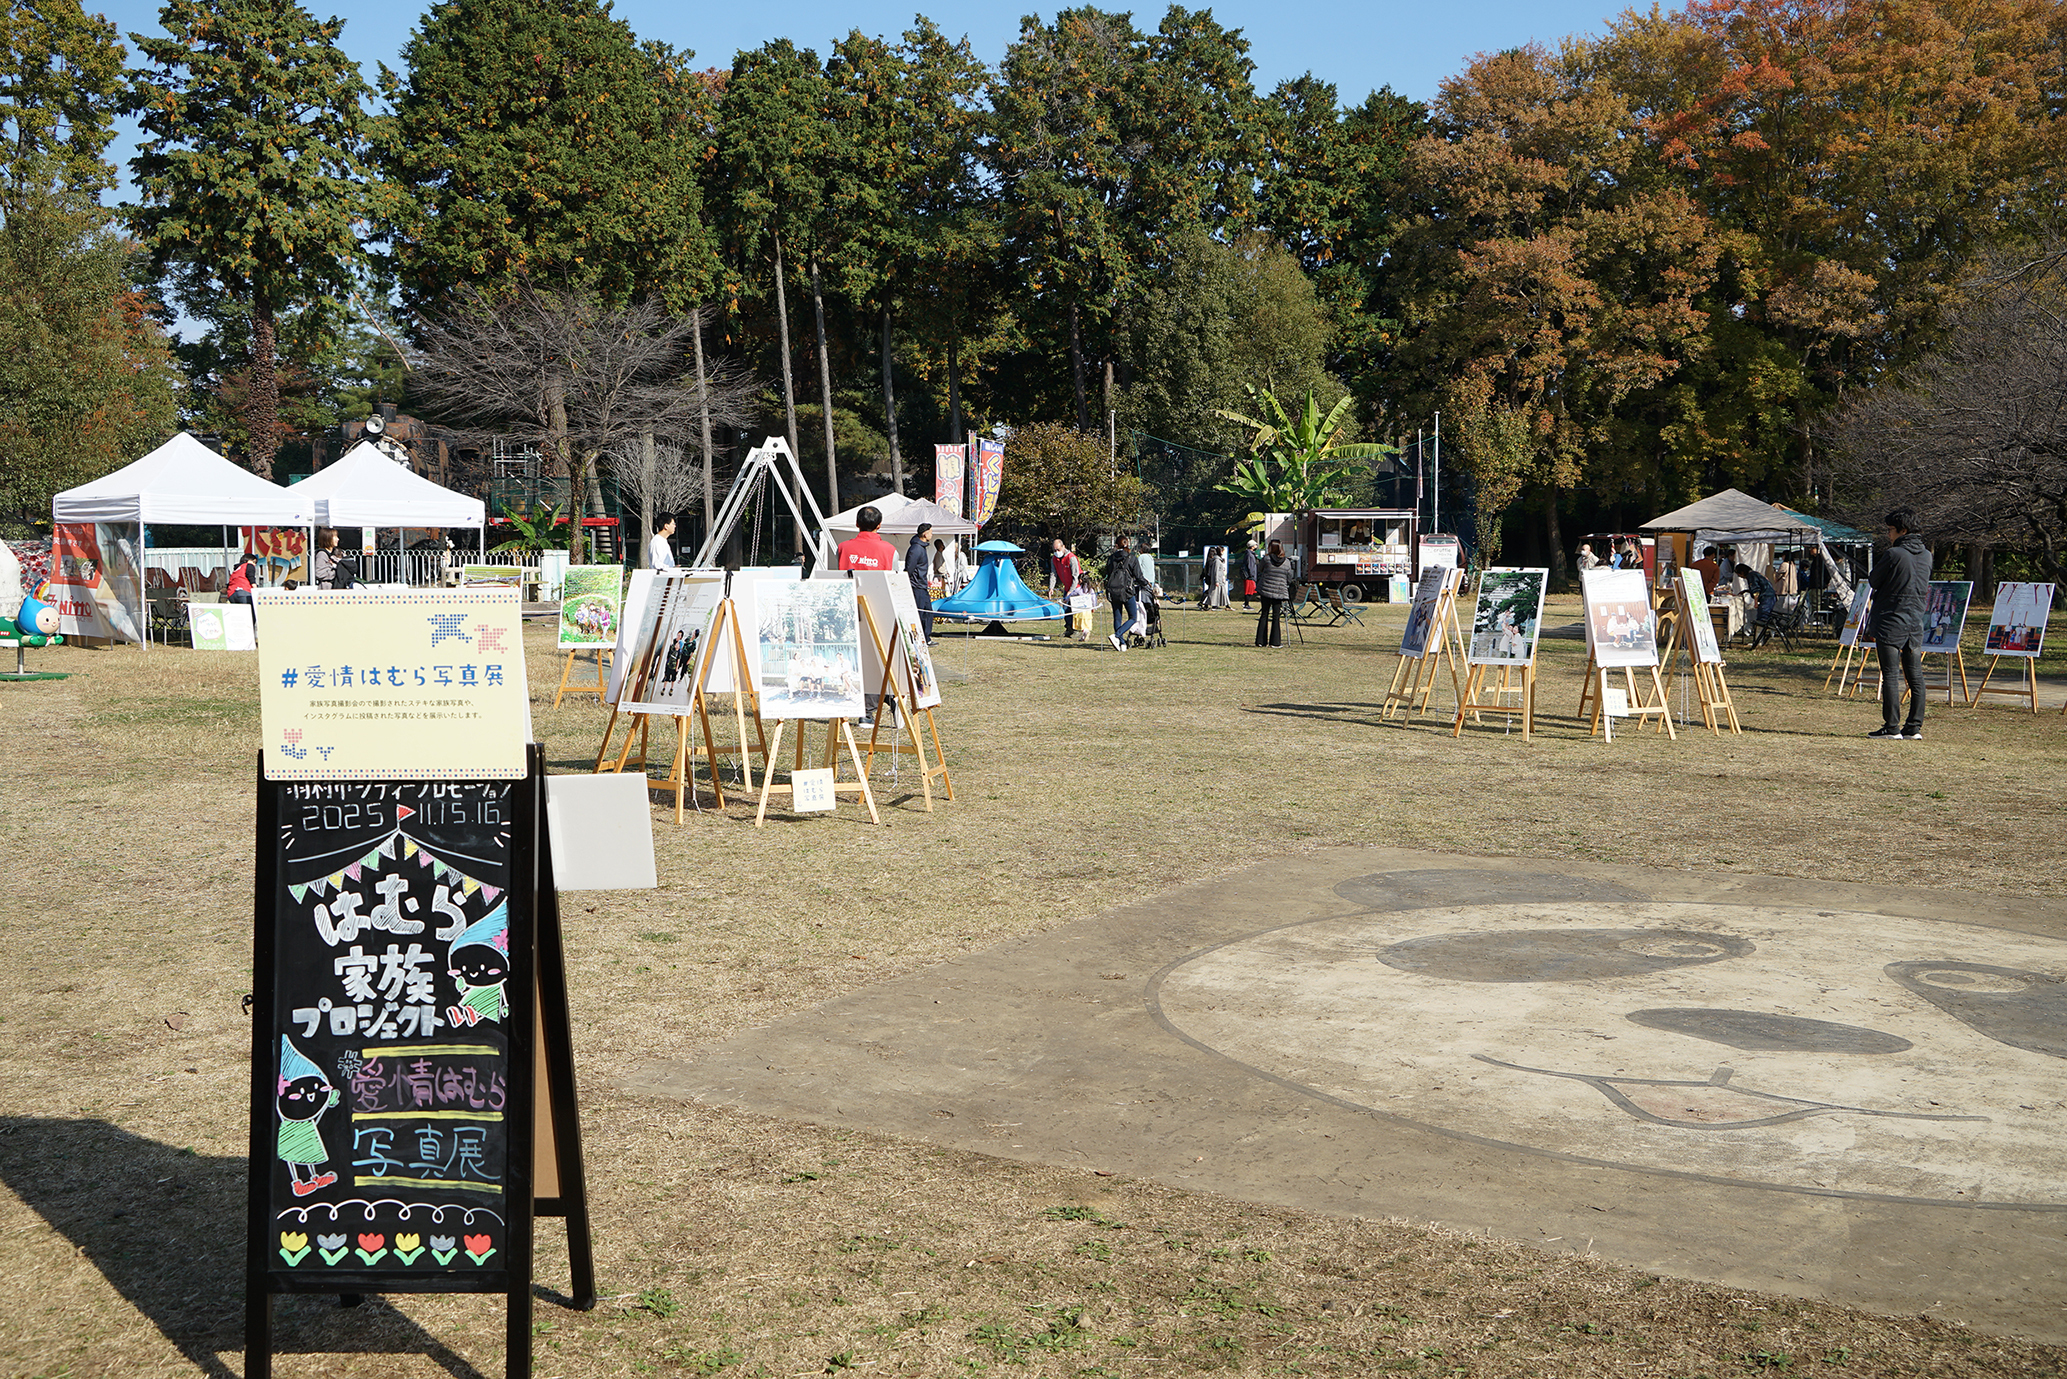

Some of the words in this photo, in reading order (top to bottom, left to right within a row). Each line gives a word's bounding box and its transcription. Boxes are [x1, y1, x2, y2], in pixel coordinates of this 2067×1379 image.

[281, 664, 504, 688] #愛情はむら写真展
[302, 803, 384, 831] 2025
[313, 874, 467, 947] はむら
[334, 943, 436, 1003] 家族
[292, 997, 445, 1039] プロジェクト
[351, 1123, 501, 1178] 写真展
